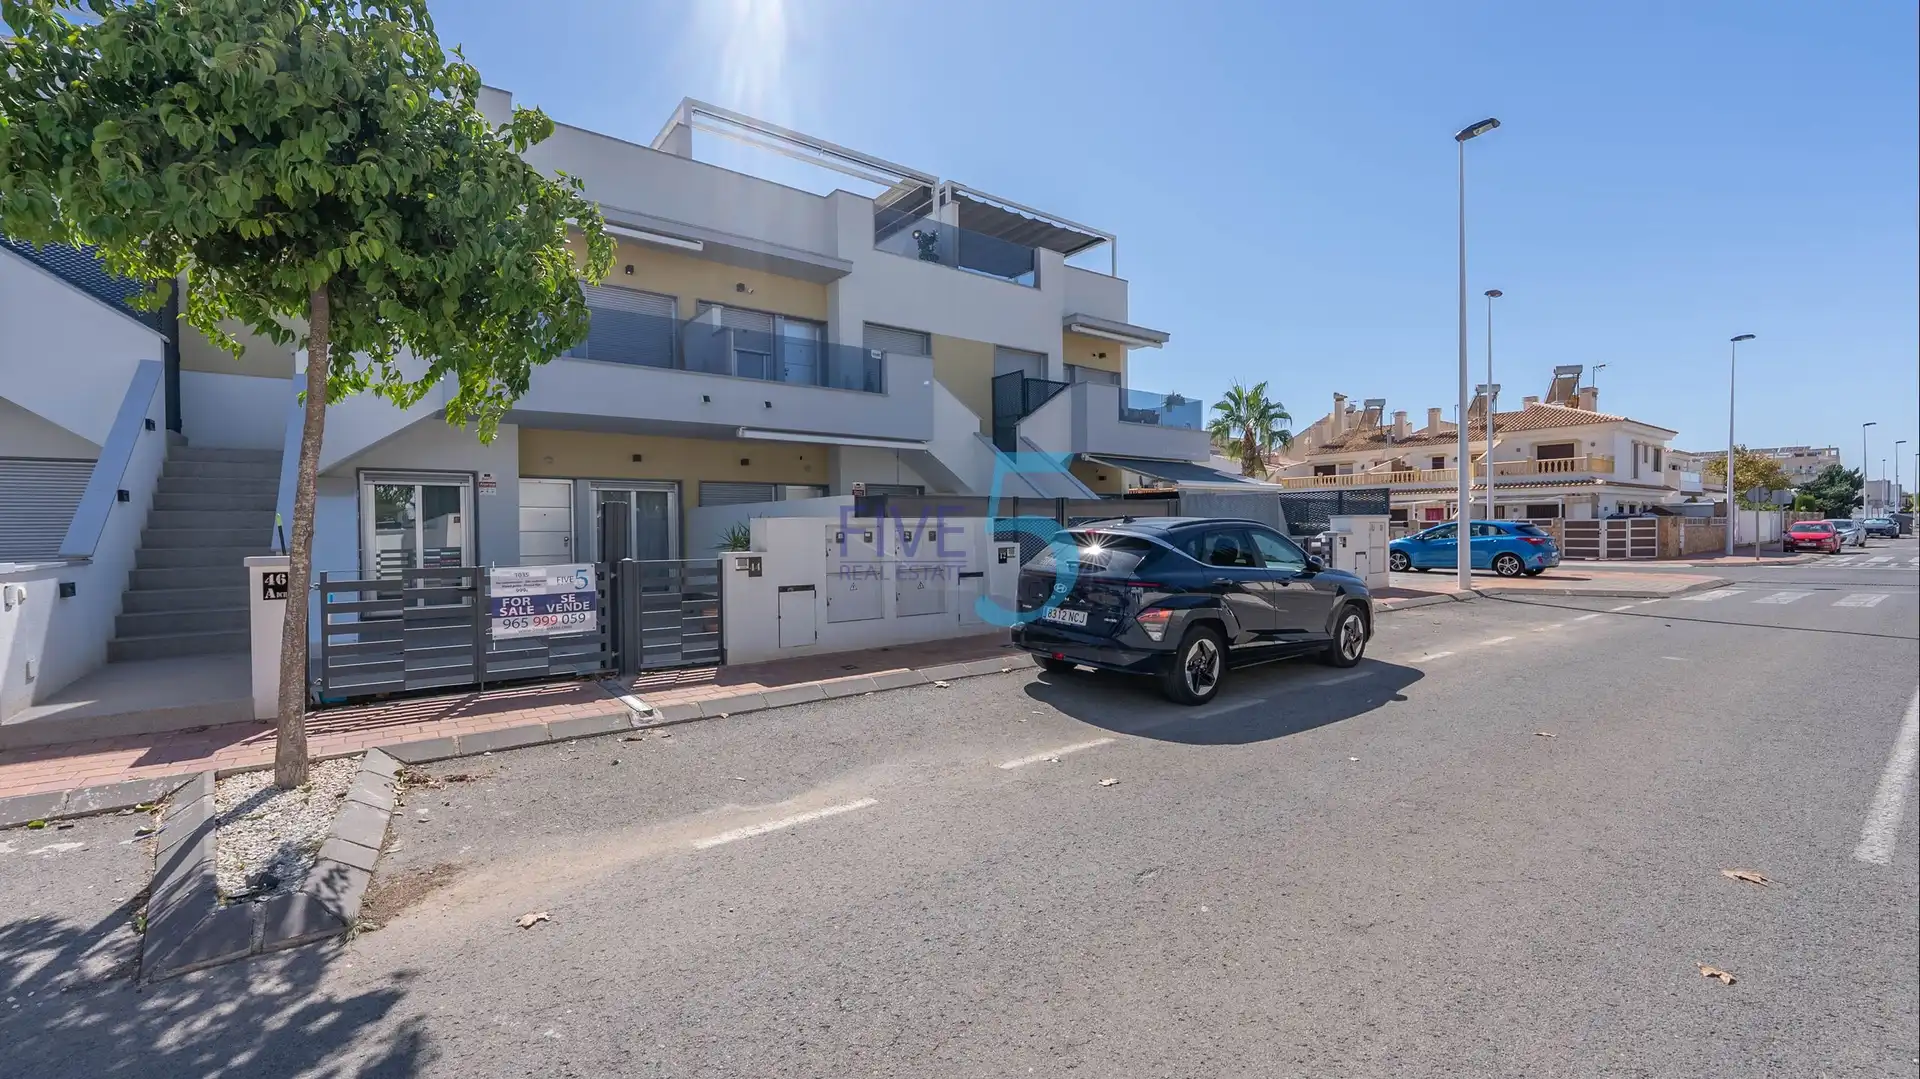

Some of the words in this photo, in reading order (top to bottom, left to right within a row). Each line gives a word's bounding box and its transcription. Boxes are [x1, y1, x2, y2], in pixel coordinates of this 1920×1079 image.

[264, 573, 287, 585] 46
[556, 575, 574, 584] FIVE
[574, 569, 589, 590] 5
[502, 596, 531, 607] FOR
[560, 593, 576, 604] SE
[499, 605, 535, 617] SALE
[546, 601, 590, 613] VENDE
[502, 617, 529, 630] 965
[532, 615, 558, 627] 999
[561, 612, 586, 625] 059
[1047, 608, 1067, 621] 8312
[1069, 612, 1086, 624] NCJ
